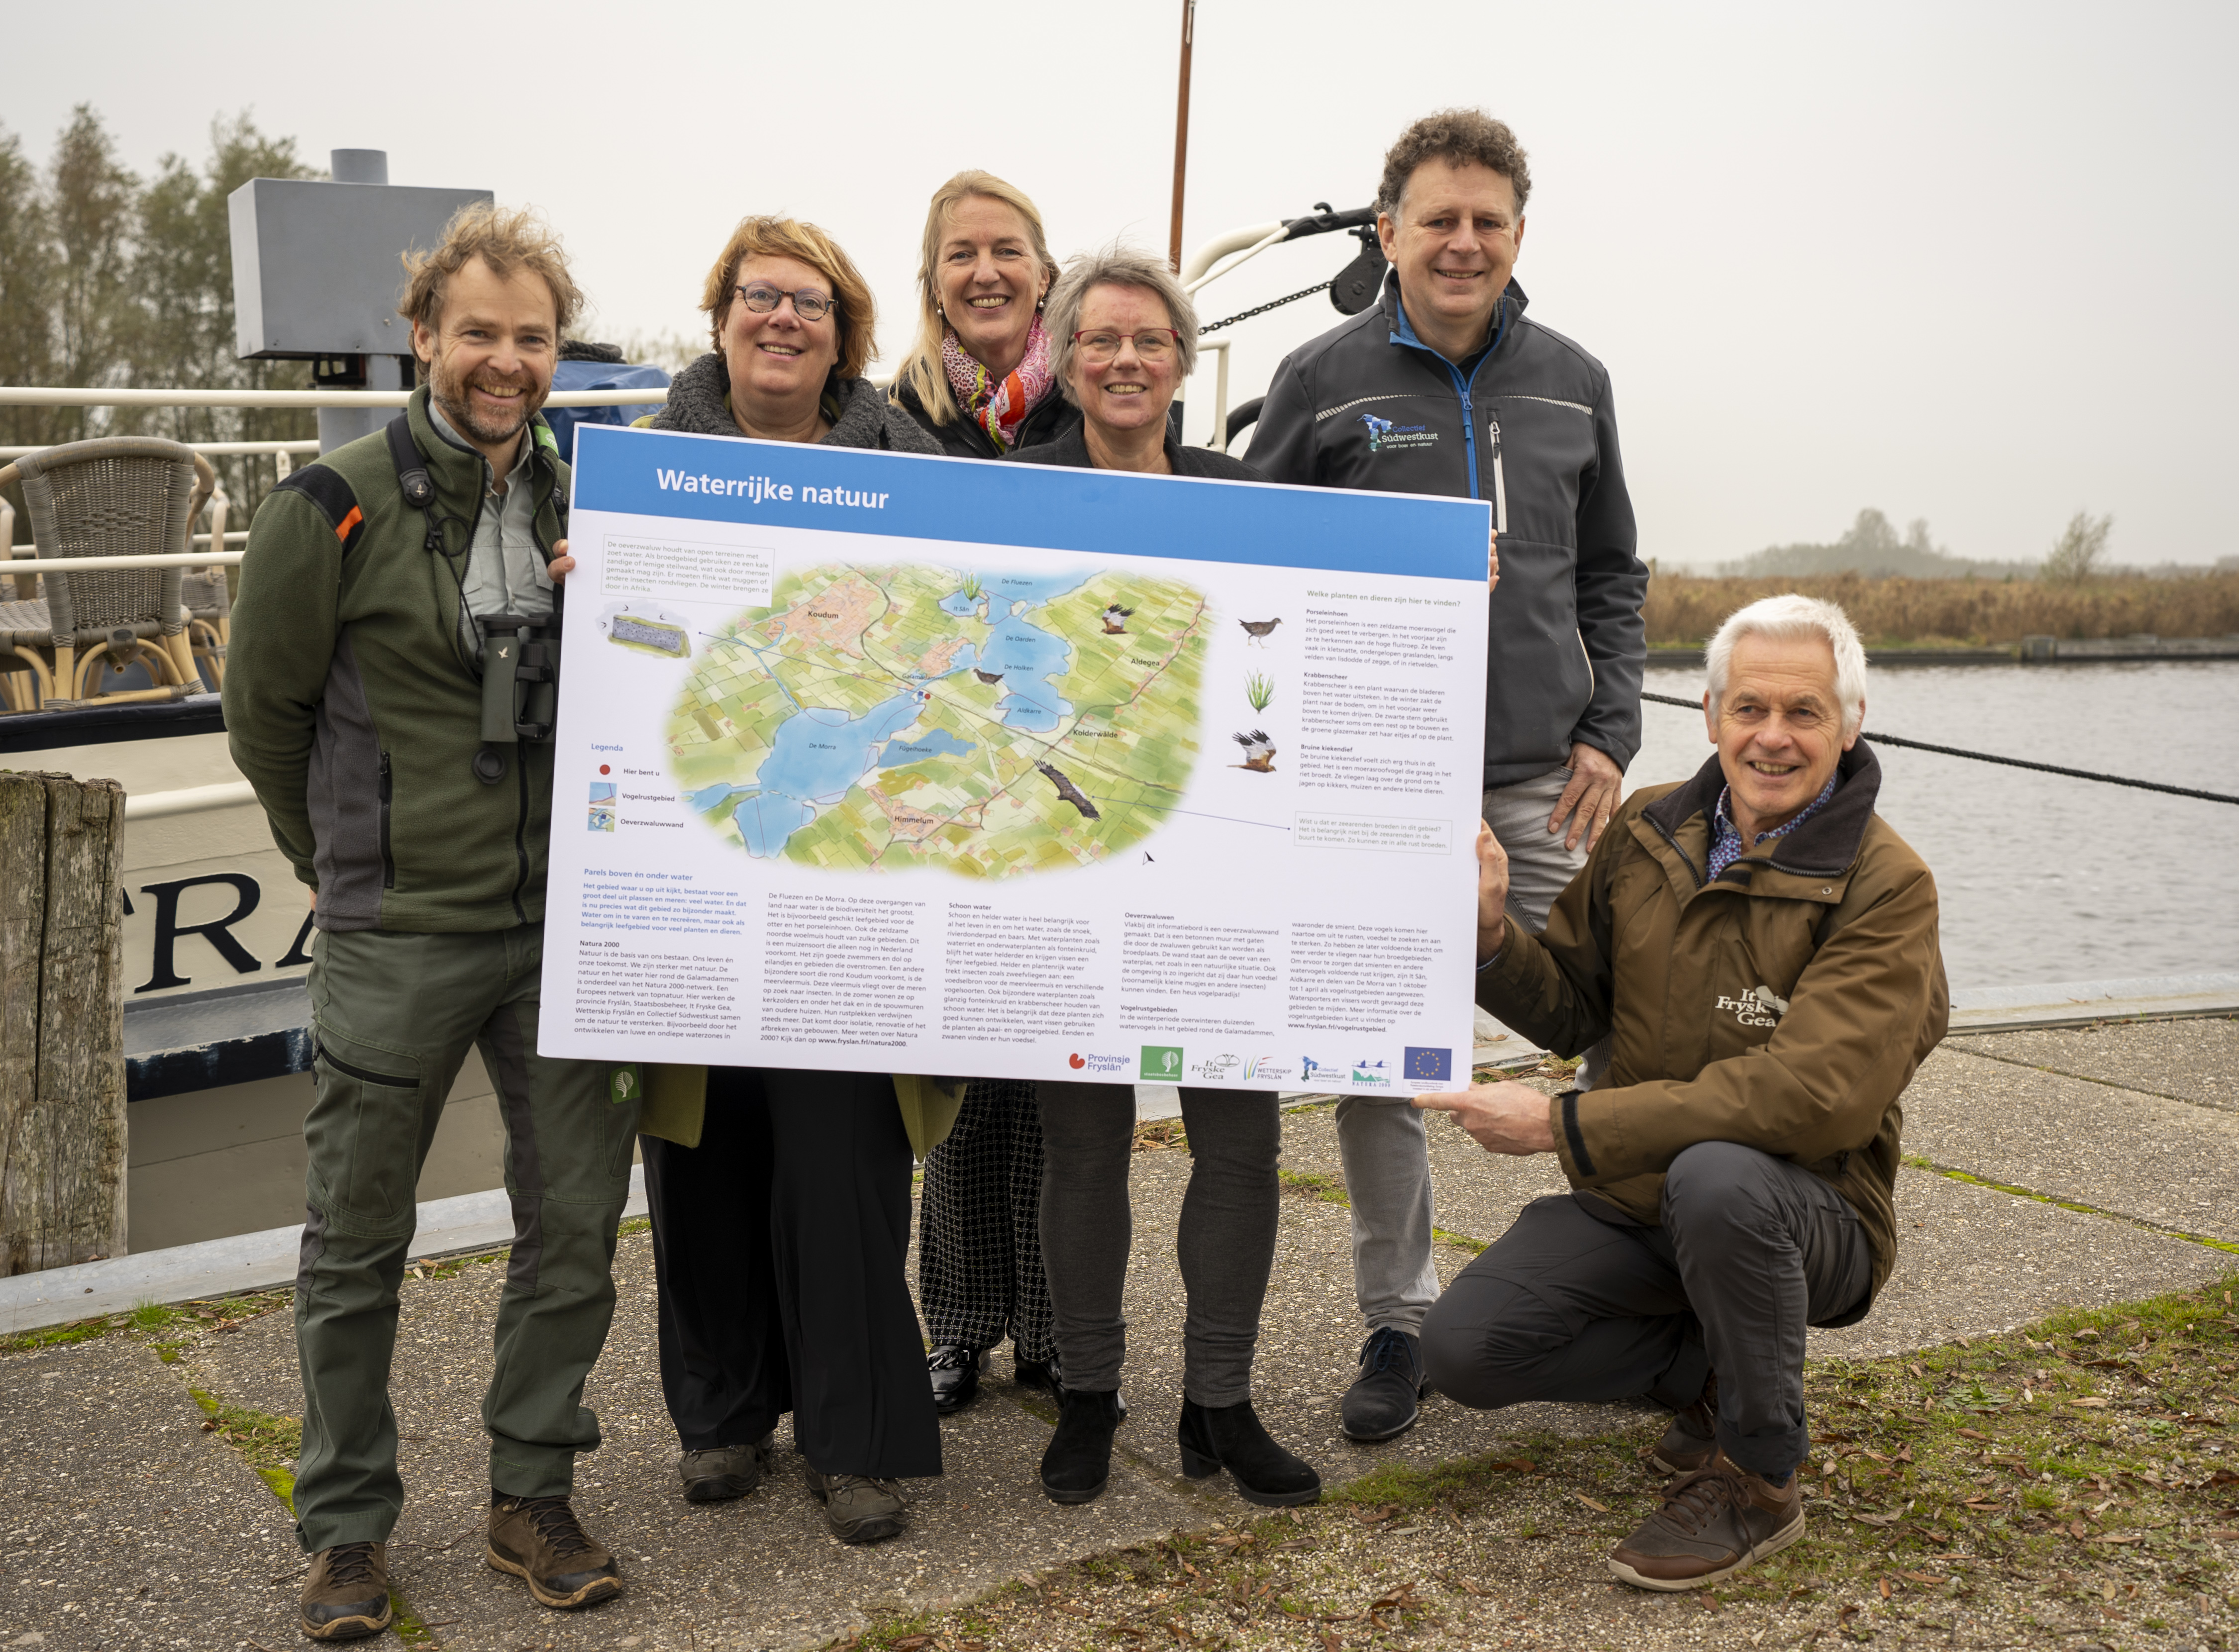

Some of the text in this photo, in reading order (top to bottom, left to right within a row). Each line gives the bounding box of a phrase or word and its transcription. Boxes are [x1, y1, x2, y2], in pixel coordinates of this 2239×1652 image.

[1381, 432, 1438, 443] Súdwestkust
[656, 468, 889, 509] Waterrijke natuur
[618, 543, 661, 551] oeverzwaluw
[1130, 658, 1160, 667] Aldegea
[1073, 729, 1118, 738] Kolderwâlde
[591, 743, 623, 752] Legenda
[621, 793, 675, 802] Vogelrustgebied
[620, 818, 684, 828] Oeverzwaluwwand
[1043, 917, 1074, 925] belangrijk
[1156, 923, 1203, 931] informatiebord
[1739, 988, 1756, 1002] It
[1120, 1004, 1177, 1013] Vogelrustgebieden
[1715, 995, 1771, 1014] Frysk
[1737, 1012, 1777, 1027] Gea
[1287, 1022, 1387, 1033] www.fryslan.frl/vogelrustgebied.
[818, 1038, 908, 1047] www.fryslan.frl/natura2000.
[1088, 1054, 1130, 1064] Provinsje
[1088, 1062, 1121, 1072] Fryslân
[1191, 1065, 1225, 1073] Fryske
